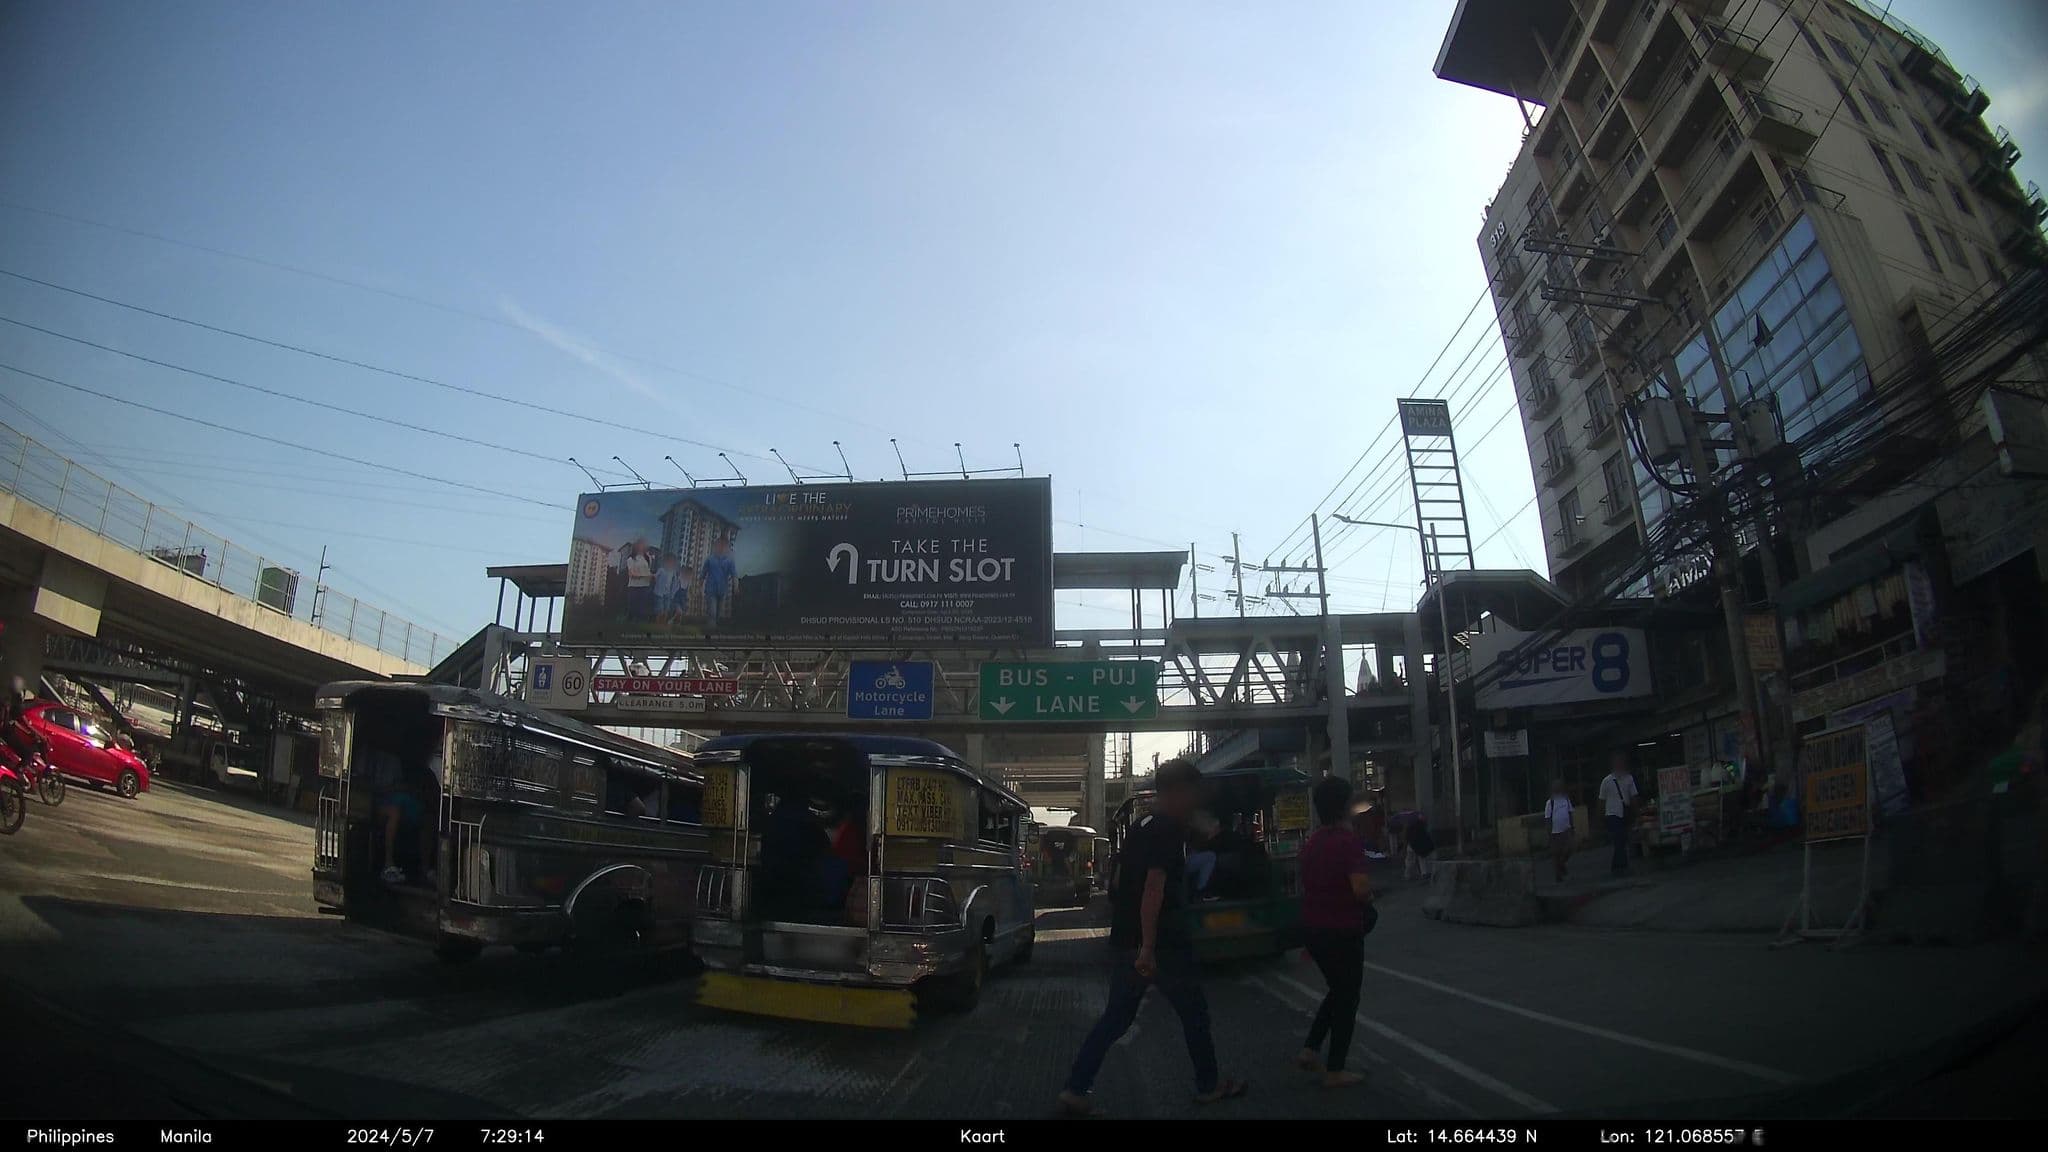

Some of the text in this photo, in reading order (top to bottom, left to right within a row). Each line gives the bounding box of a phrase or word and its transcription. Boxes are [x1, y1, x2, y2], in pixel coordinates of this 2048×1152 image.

[1408, 417, 1447, 427] PLAZA
[803, 492, 826, 504] THE
[897, 505, 986, 519] PRIMEHOMES
[892, 539, 988, 553] TAKE THE
[867, 557, 1016, 582] TURN SLOT
[920, 600, 938, 608] 0917
[941, 600, 953, 608] 111
[956, 600, 974, 608] 0007
[1592, 632, 1630, 693] 8
[565, 677, 582, 690] 60
[1000, 669, 1048, 686] BUS
[1093, 668, 1136, 686] PUJ
[597, 680, 733, 692] STAY ON YOUR LANE
[619, 700, 674, 708] CLEARANCE
[855, 690, 926, 705] Motorcycle
[874, 705, 905, 717] Lane
[1036, 696, 1100, 713] LANE
[896, 805, 919, 818] TEXT
